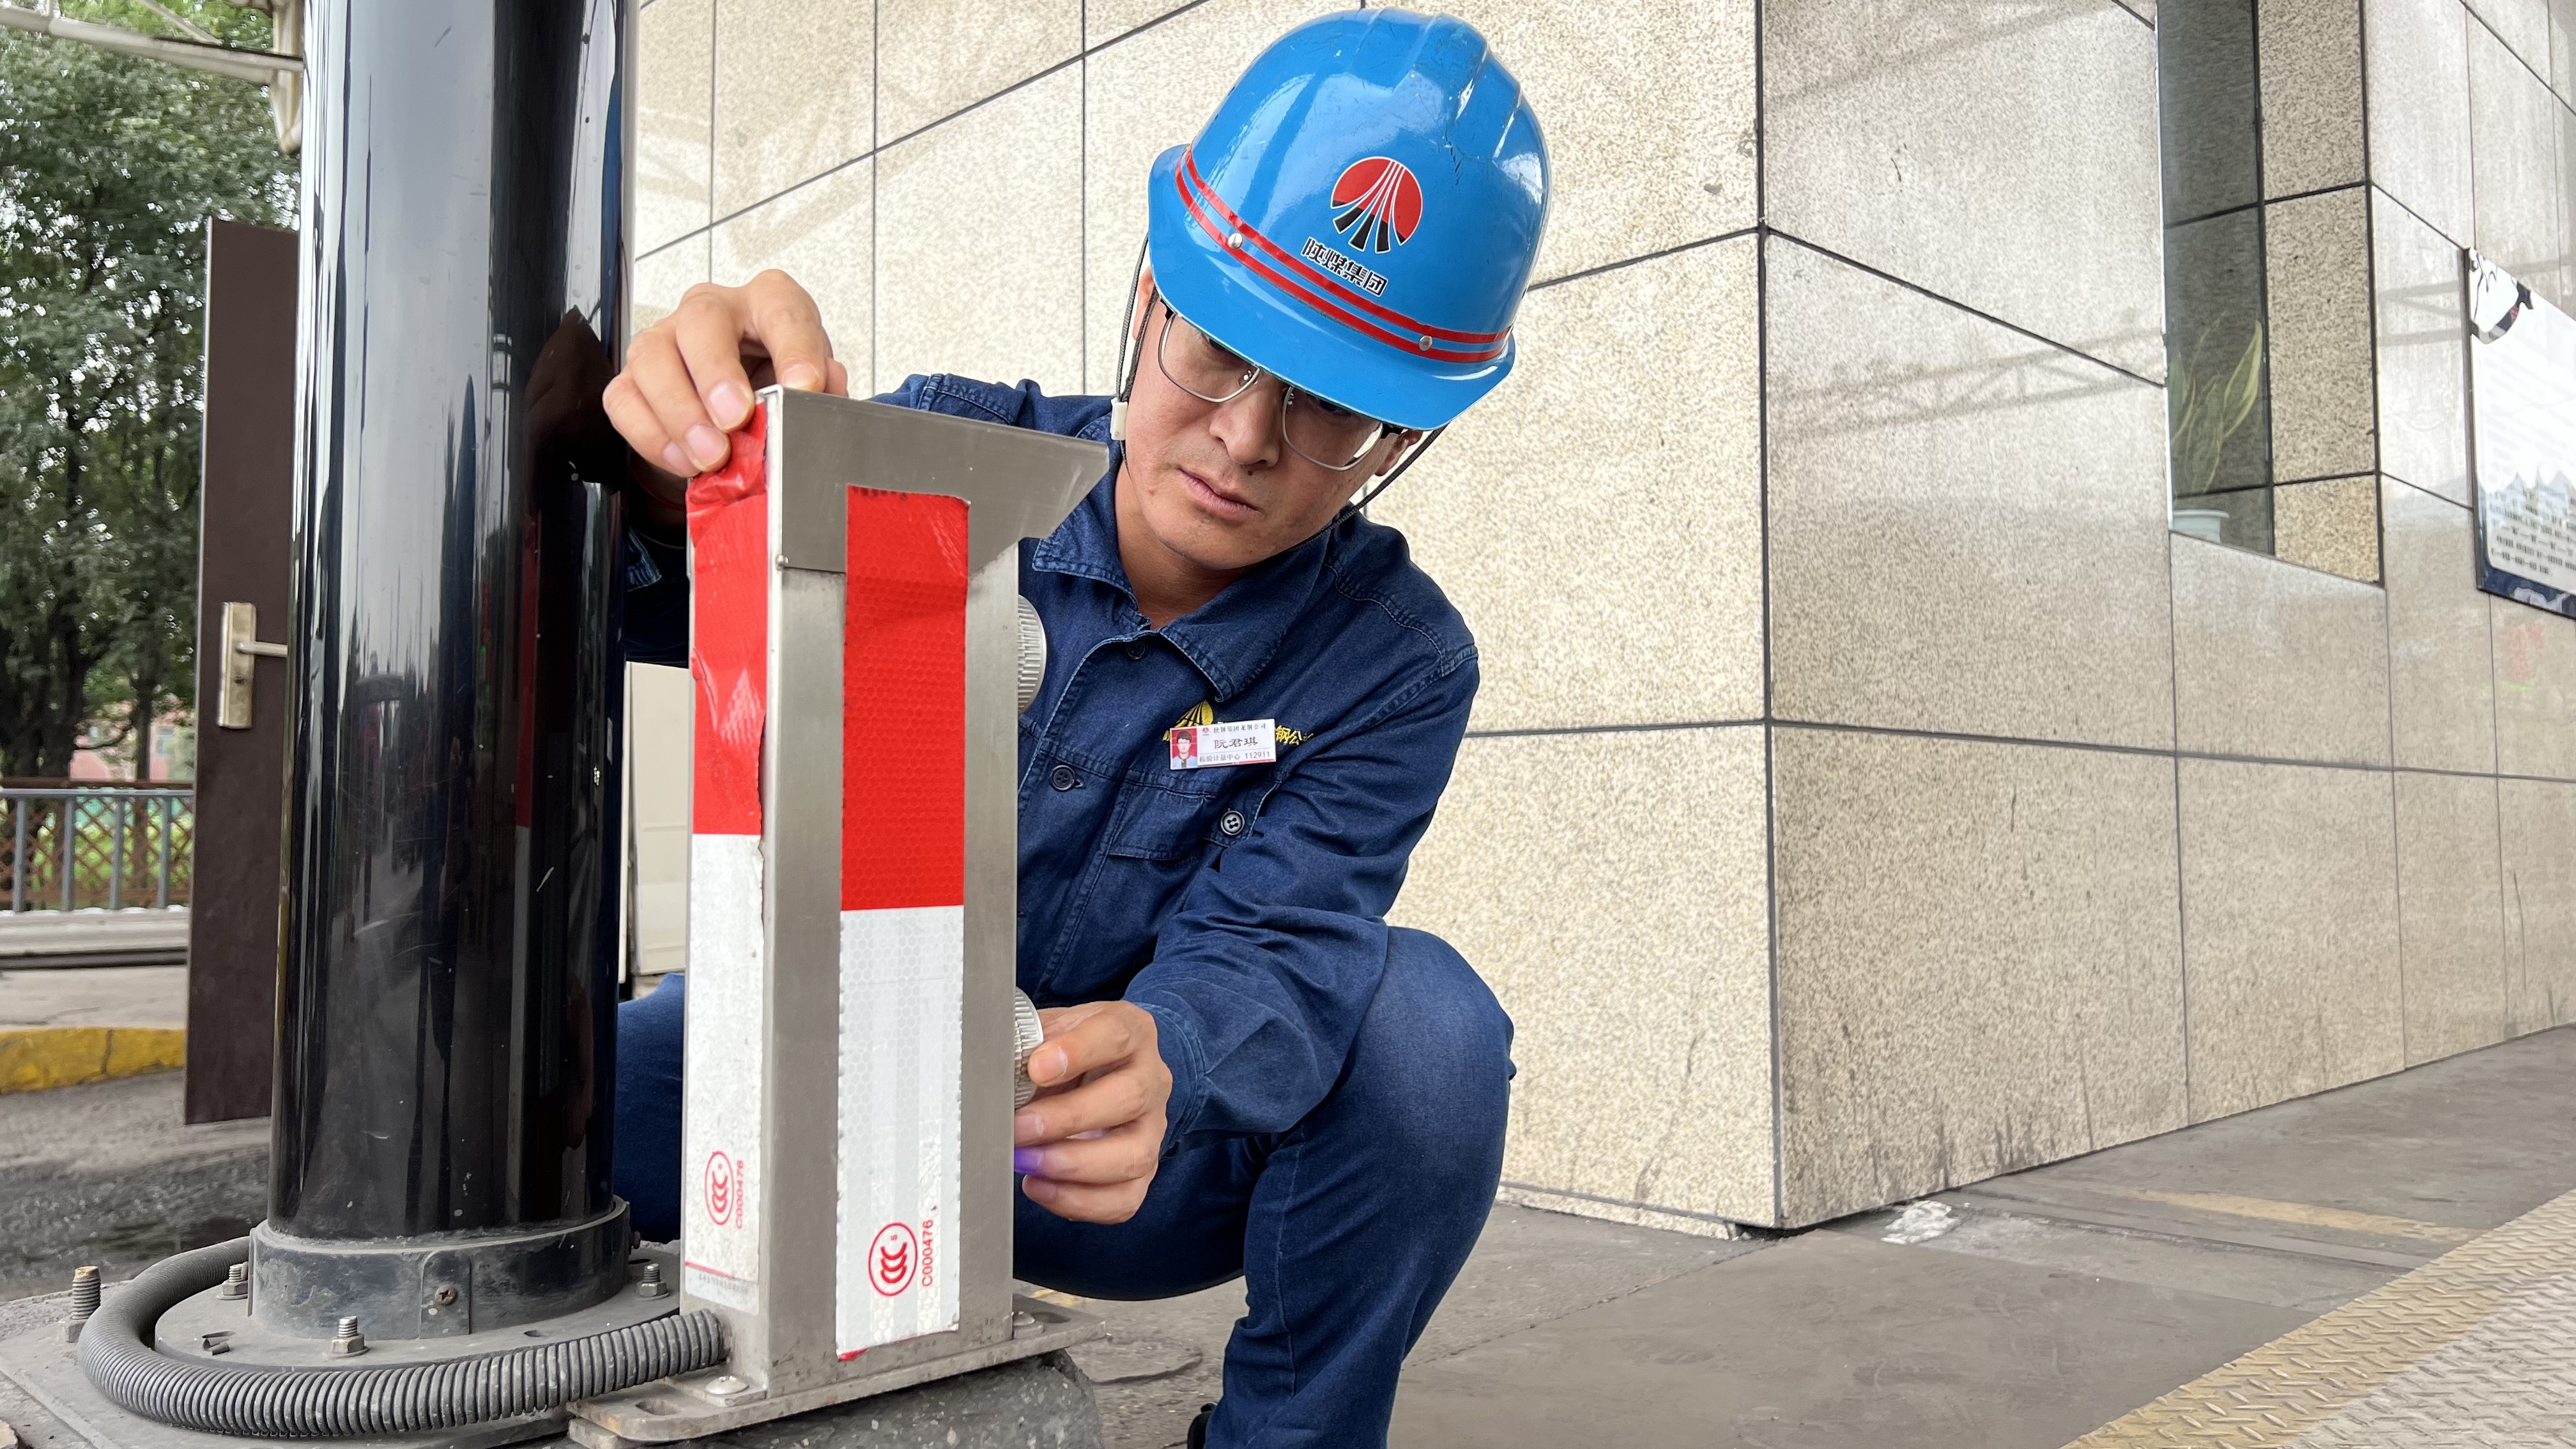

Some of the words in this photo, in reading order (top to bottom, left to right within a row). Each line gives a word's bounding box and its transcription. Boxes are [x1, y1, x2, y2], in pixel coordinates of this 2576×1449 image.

[1301, 237, 1388, 296] 陕煤集团
[736, 1160, 744, 1229] C000476
[921, 1219, 933, 1287] C000476
